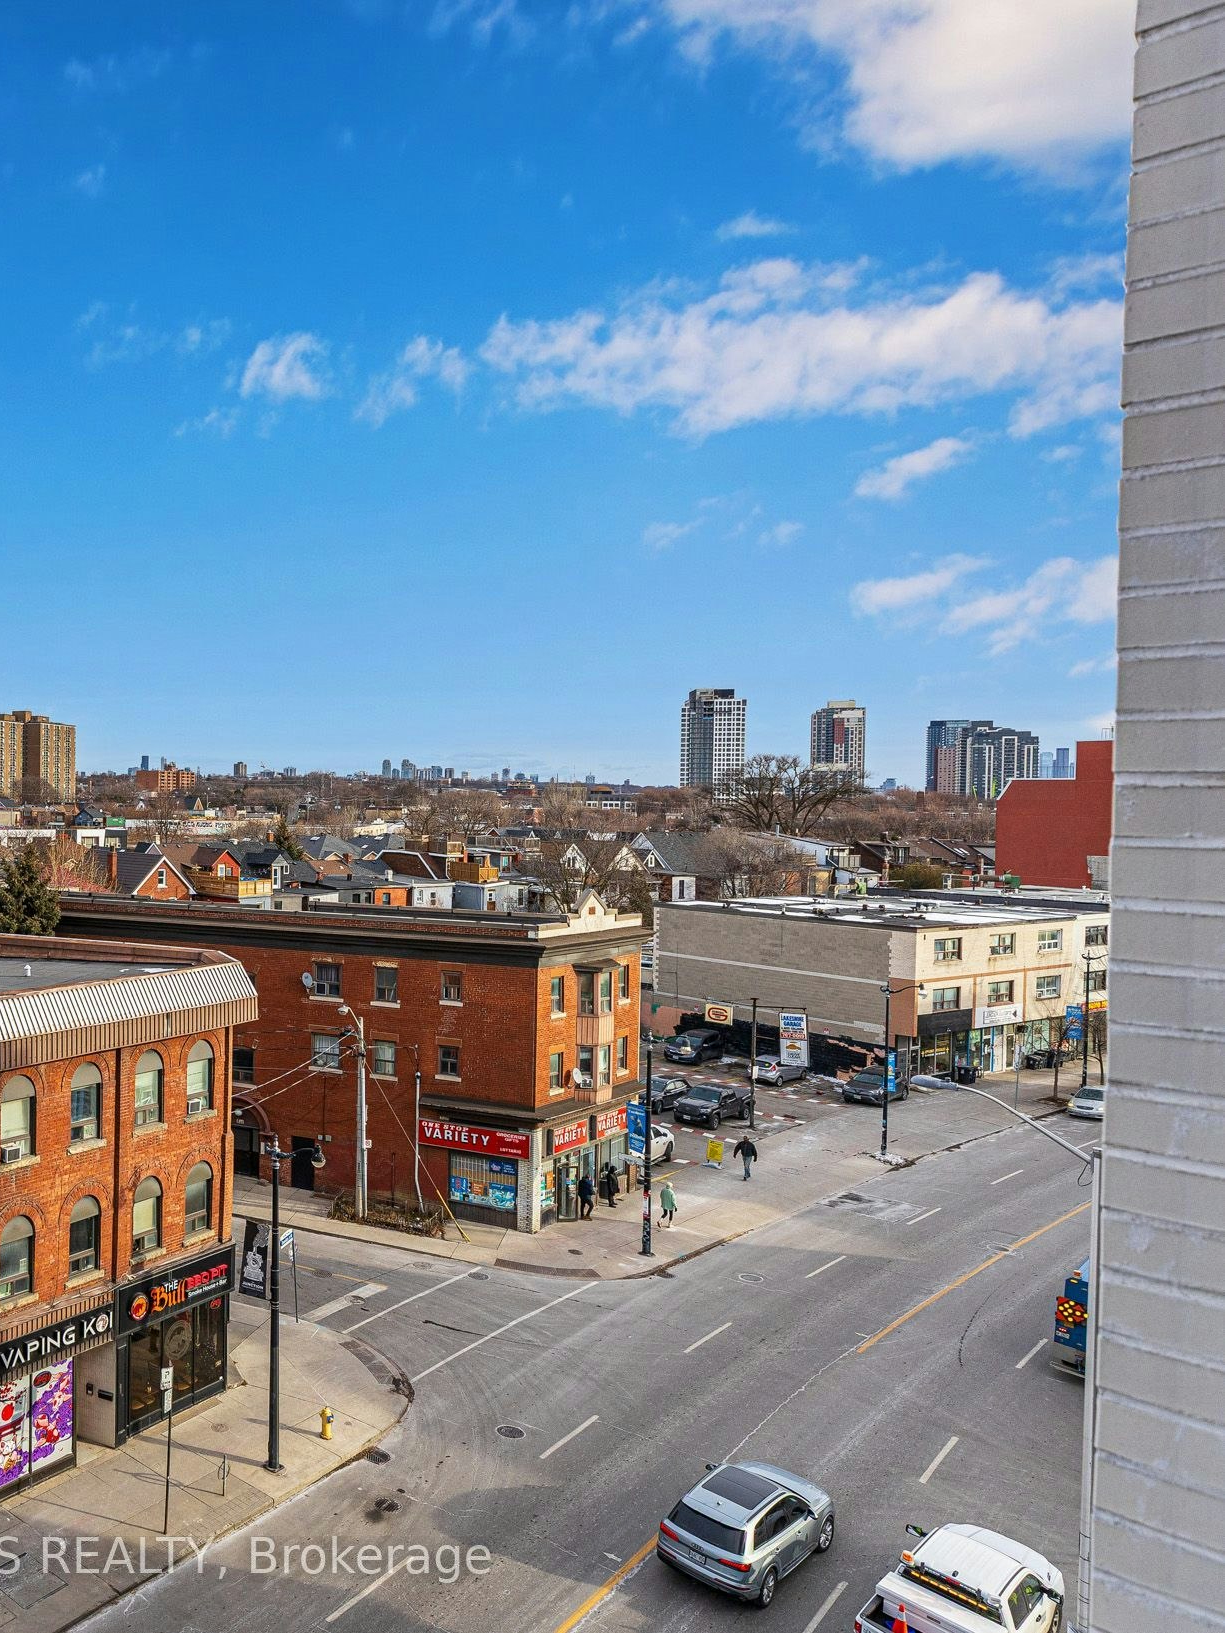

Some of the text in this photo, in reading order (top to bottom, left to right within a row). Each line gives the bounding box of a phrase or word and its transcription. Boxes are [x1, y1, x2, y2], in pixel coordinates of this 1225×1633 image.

[443, 1124, 469, 1132] STOP
[597, 1112, 627, 1132] VARIETY
[424, 1127, 490, 1146] VARIETY
[554, 1126, 587, 1147] VARIETY
[164, 1280, 179, 1293] THE
[185, 1271, 210, 1290] BBQ
[209, 1264, 228, 1280] PIT
[242, 1281, 264, 1290] JUNCTION
[150, 1278, 186, 1312] Bull
[187, 1286, 203, 1298] Smoke
[0, 1326, 76, 1369] VAPING
